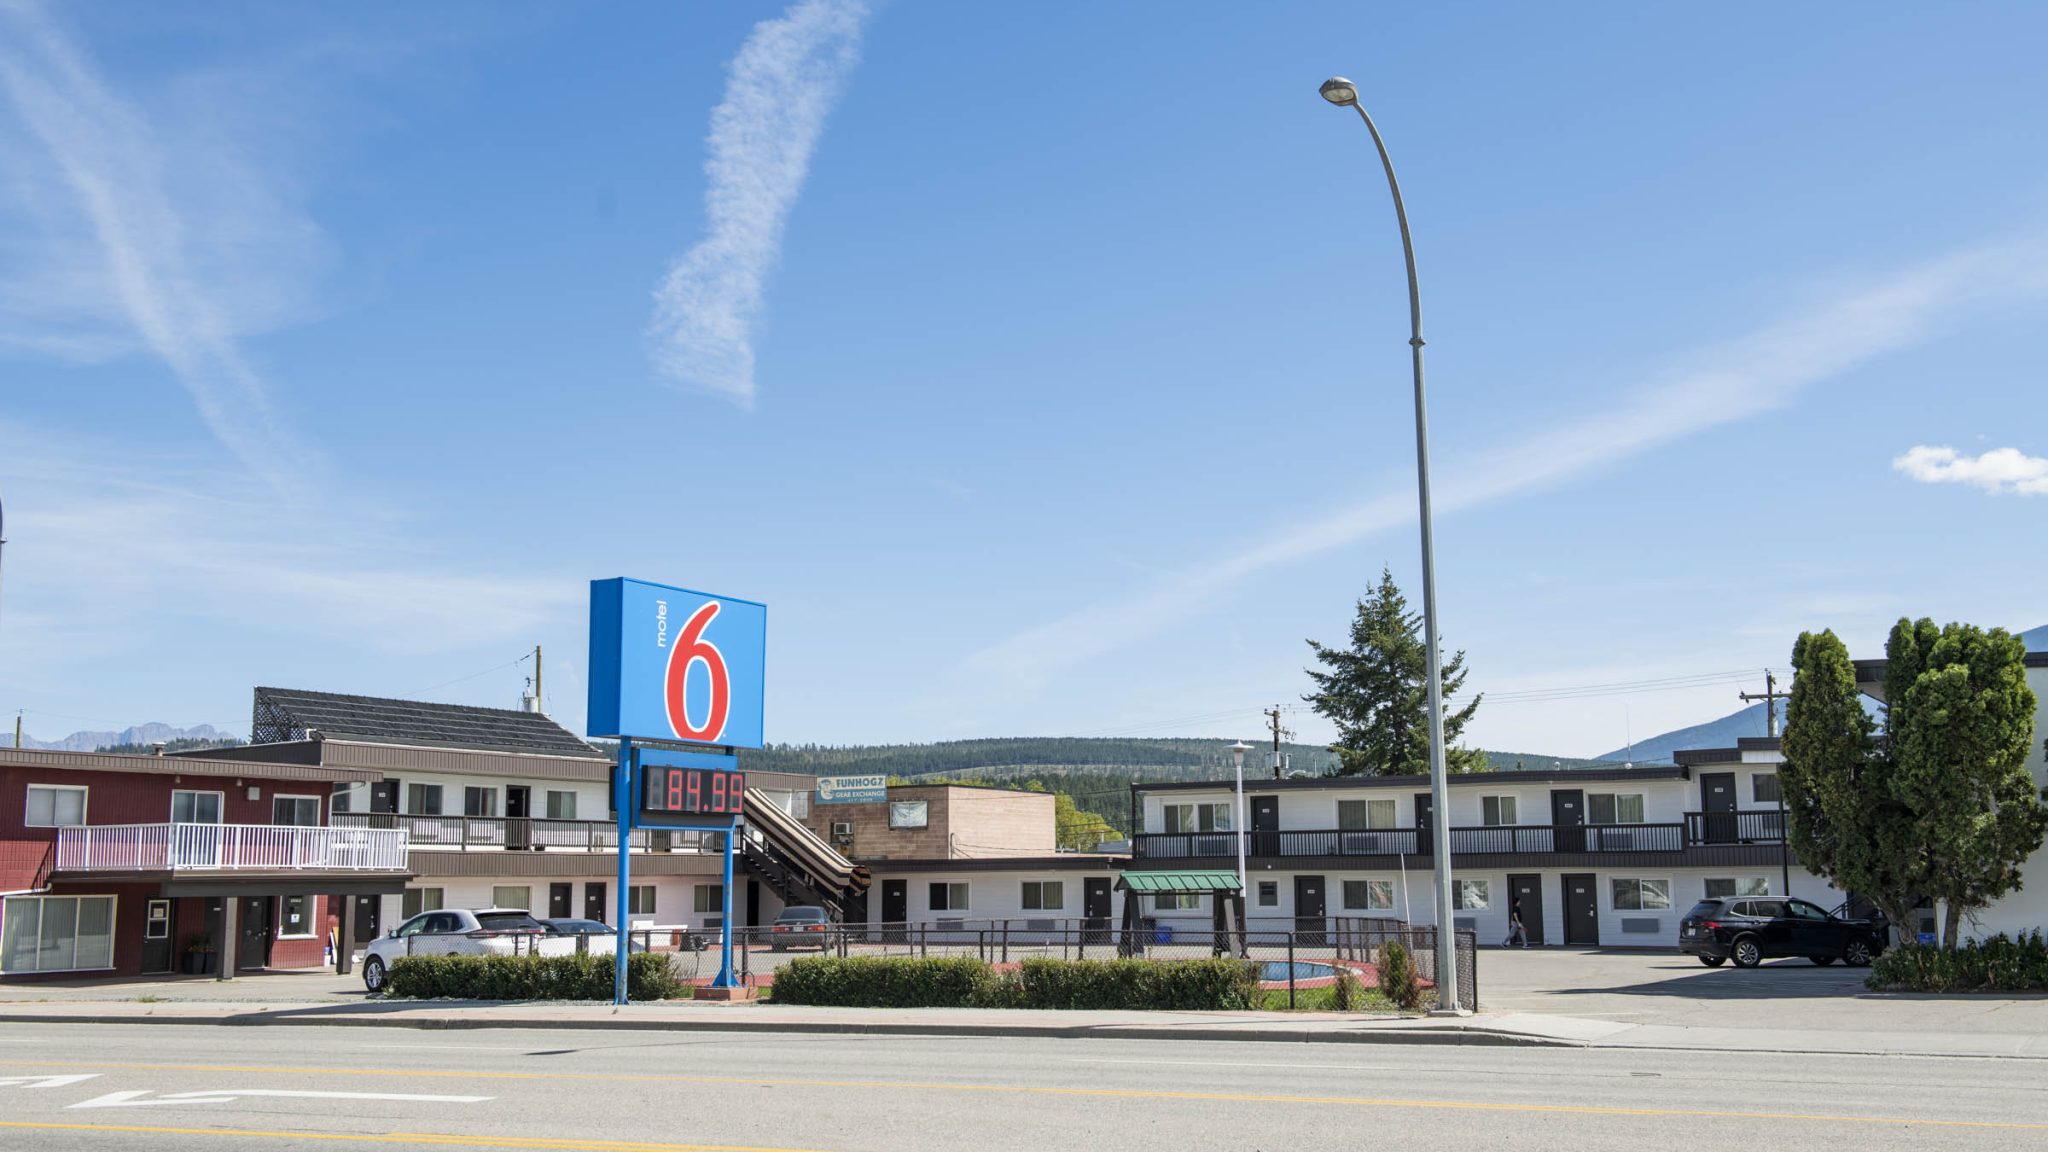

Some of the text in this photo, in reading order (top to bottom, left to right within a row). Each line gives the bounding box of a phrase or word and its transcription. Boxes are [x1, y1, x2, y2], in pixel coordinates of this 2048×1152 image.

[656, 600, 731, 742] motel 6
[668, 769, 743, 813] 84.99
[836, 777, 884, 788] FUNHOGZ
